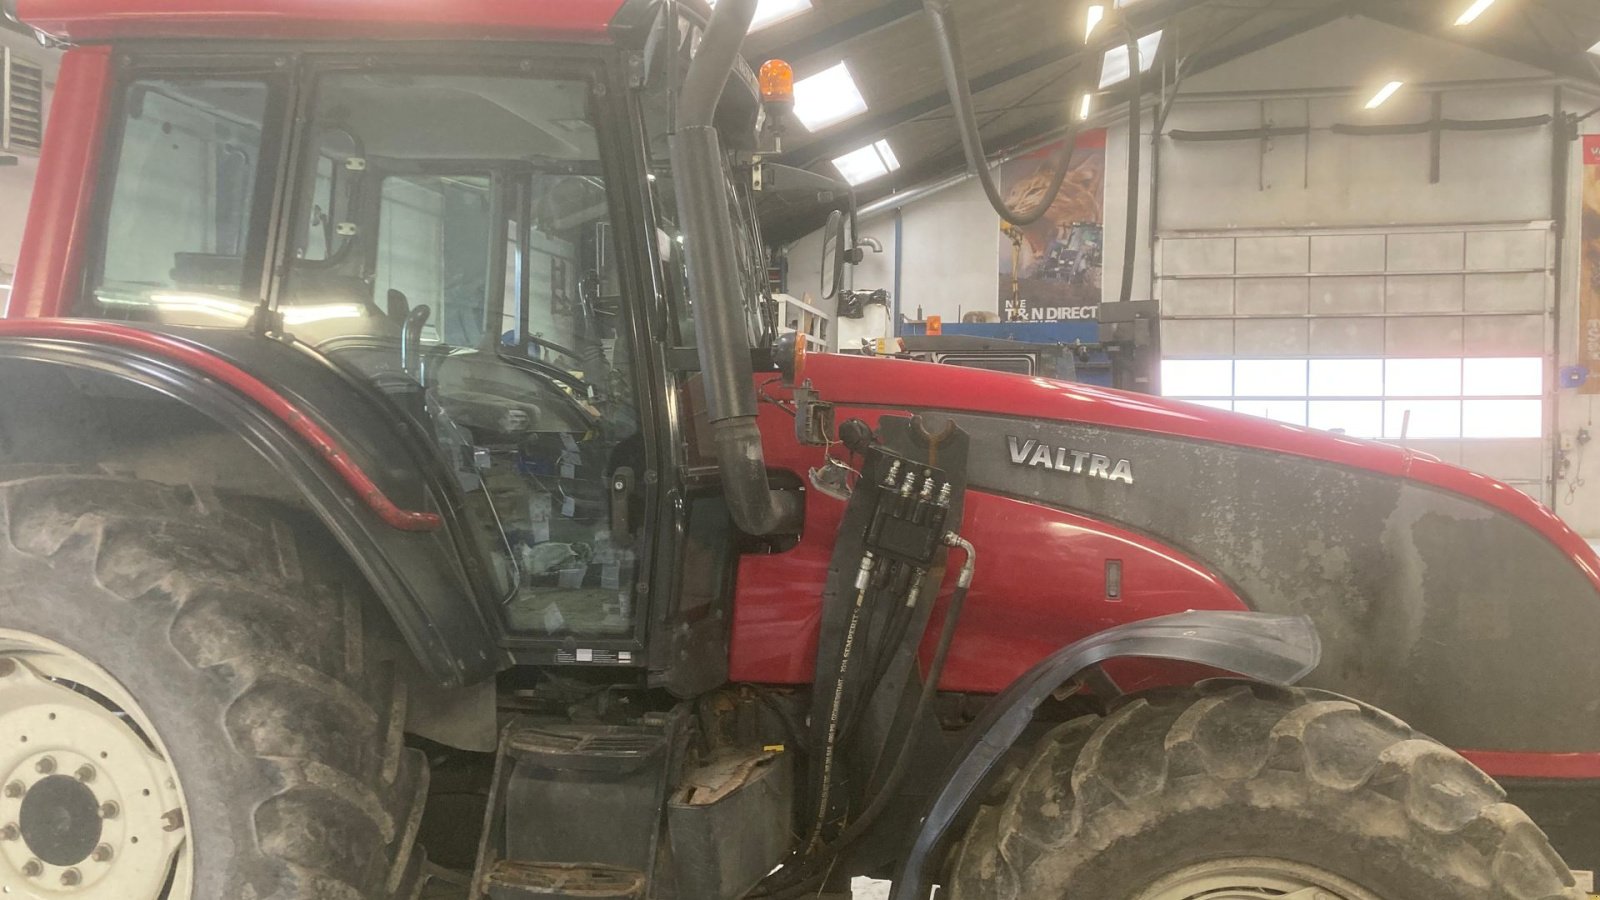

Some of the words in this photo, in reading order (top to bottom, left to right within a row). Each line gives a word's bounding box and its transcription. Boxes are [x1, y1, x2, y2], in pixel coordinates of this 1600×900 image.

[1017, 308, 1029, 320] &
[1031, 307, 1044, 320] N
[1046, 305, 1098, 320] DIRECT
[1007, 435, 1134, 485] VALTRA
